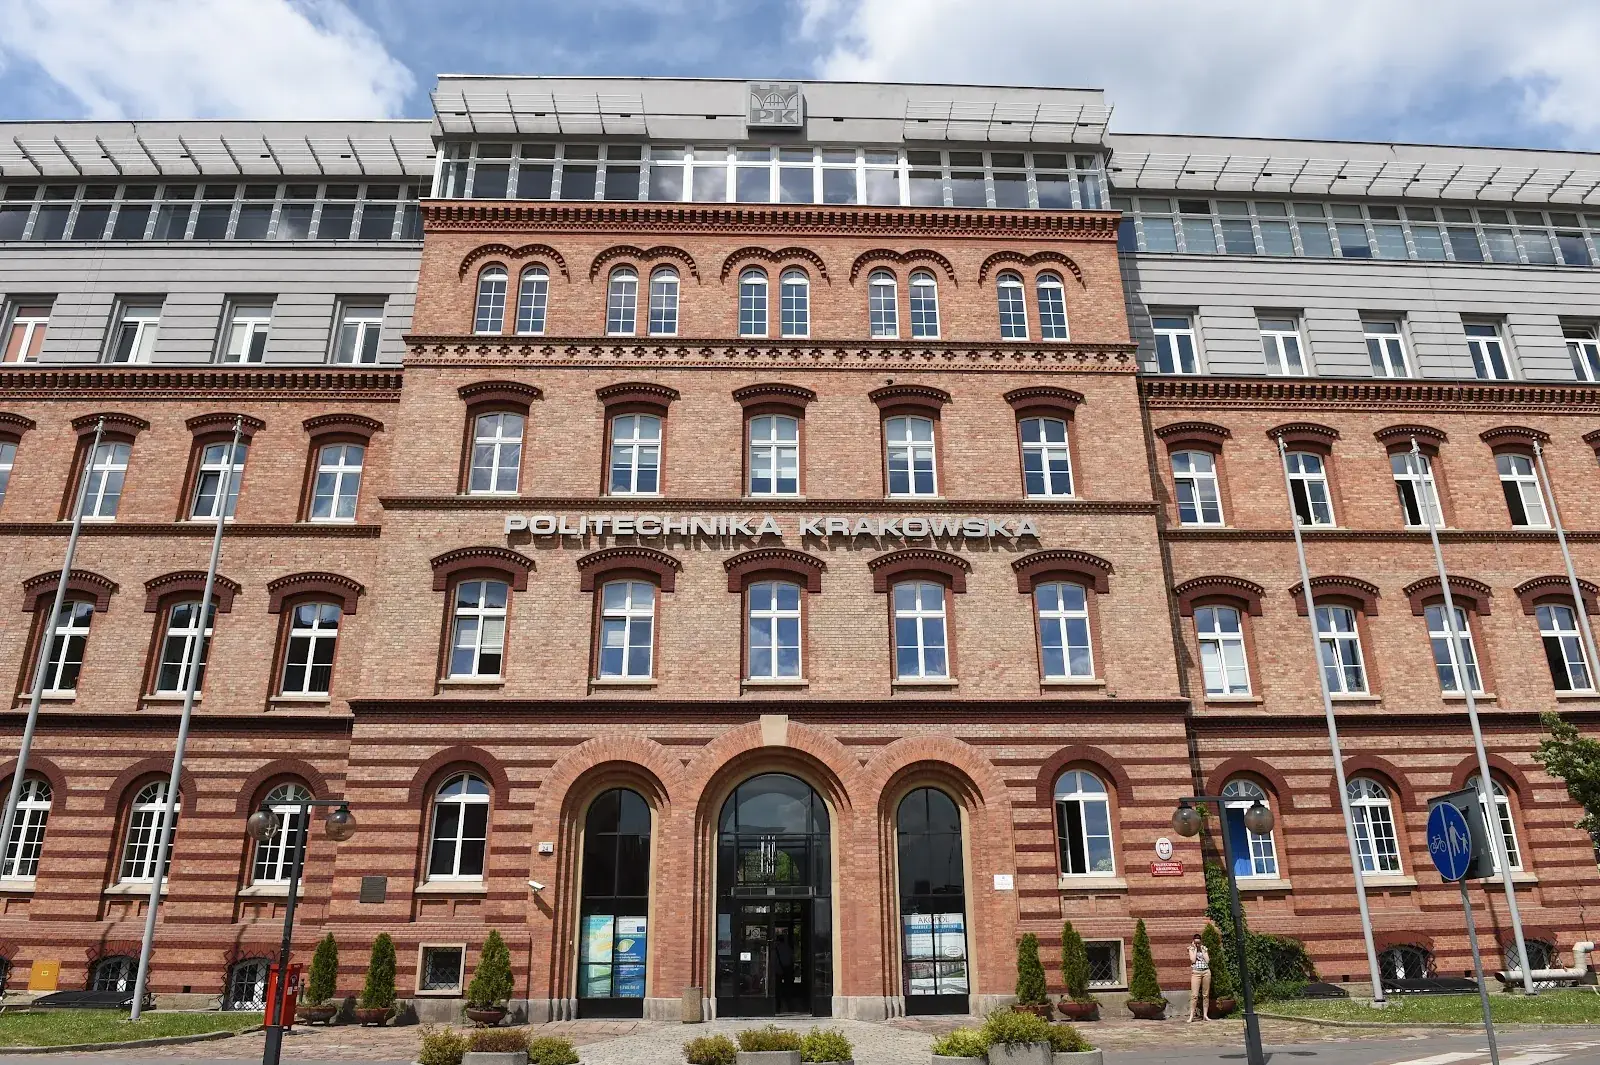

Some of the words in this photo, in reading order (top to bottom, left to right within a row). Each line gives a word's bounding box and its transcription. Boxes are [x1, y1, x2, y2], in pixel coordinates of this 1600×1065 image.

[751, 110, 796, 122] PK
[504, 515, 783, 536] POLITECHNIKA
[799, 516, 1040, 537] KRAKOWSKA
